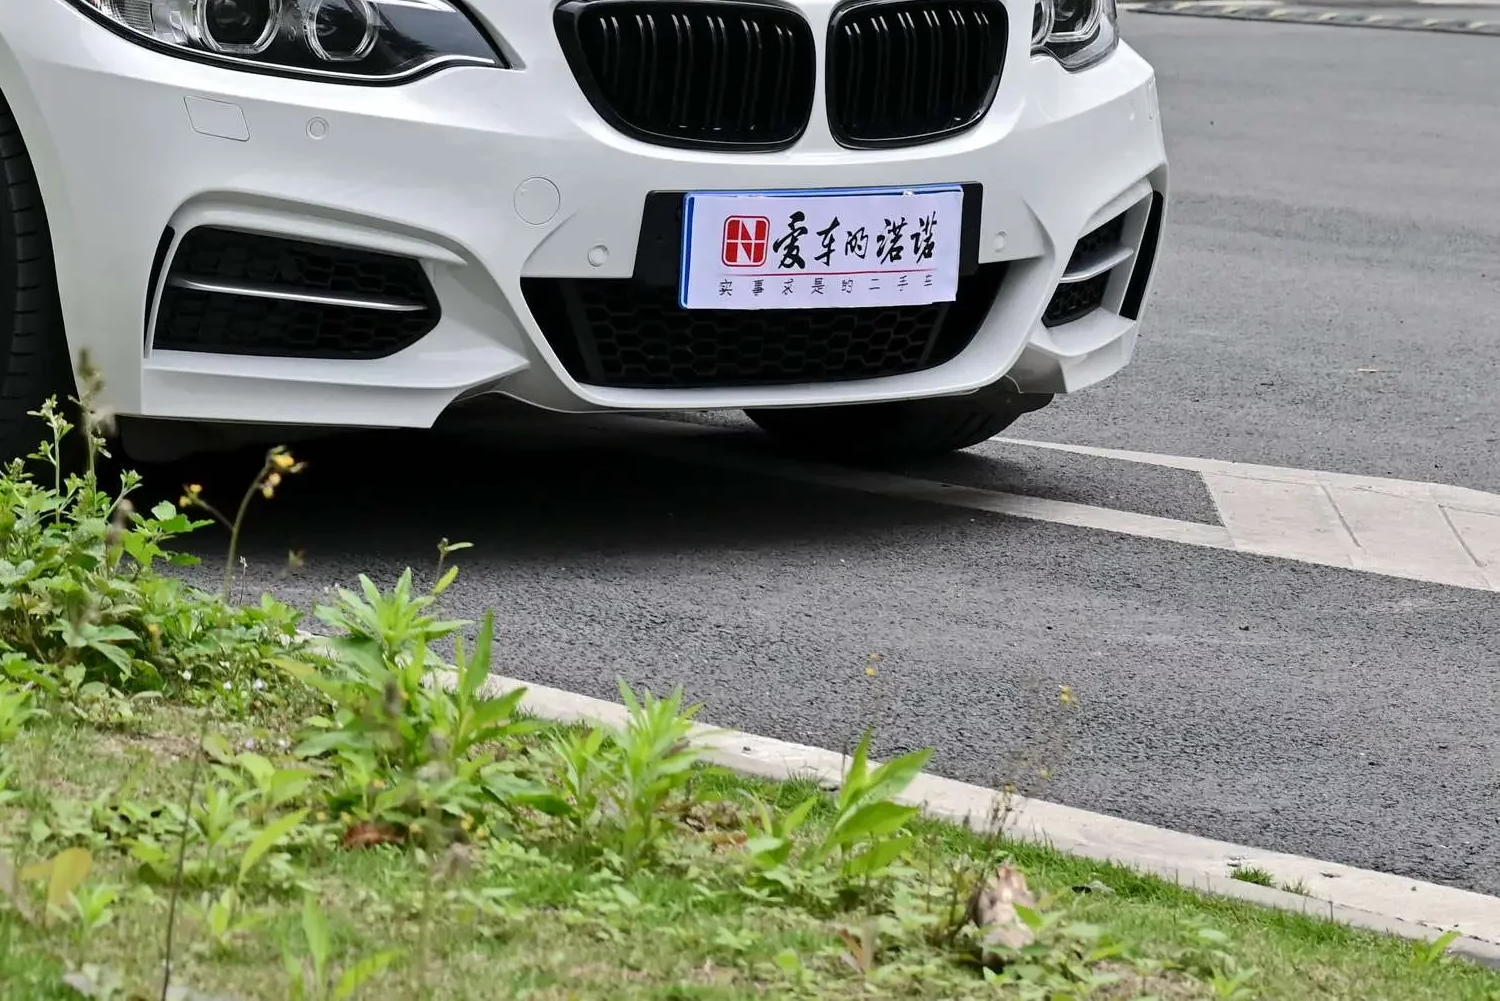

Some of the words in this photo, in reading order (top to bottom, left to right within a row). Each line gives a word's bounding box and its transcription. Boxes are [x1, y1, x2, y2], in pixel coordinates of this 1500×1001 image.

[773, 211, 937, 270] 爱车的诺诺
